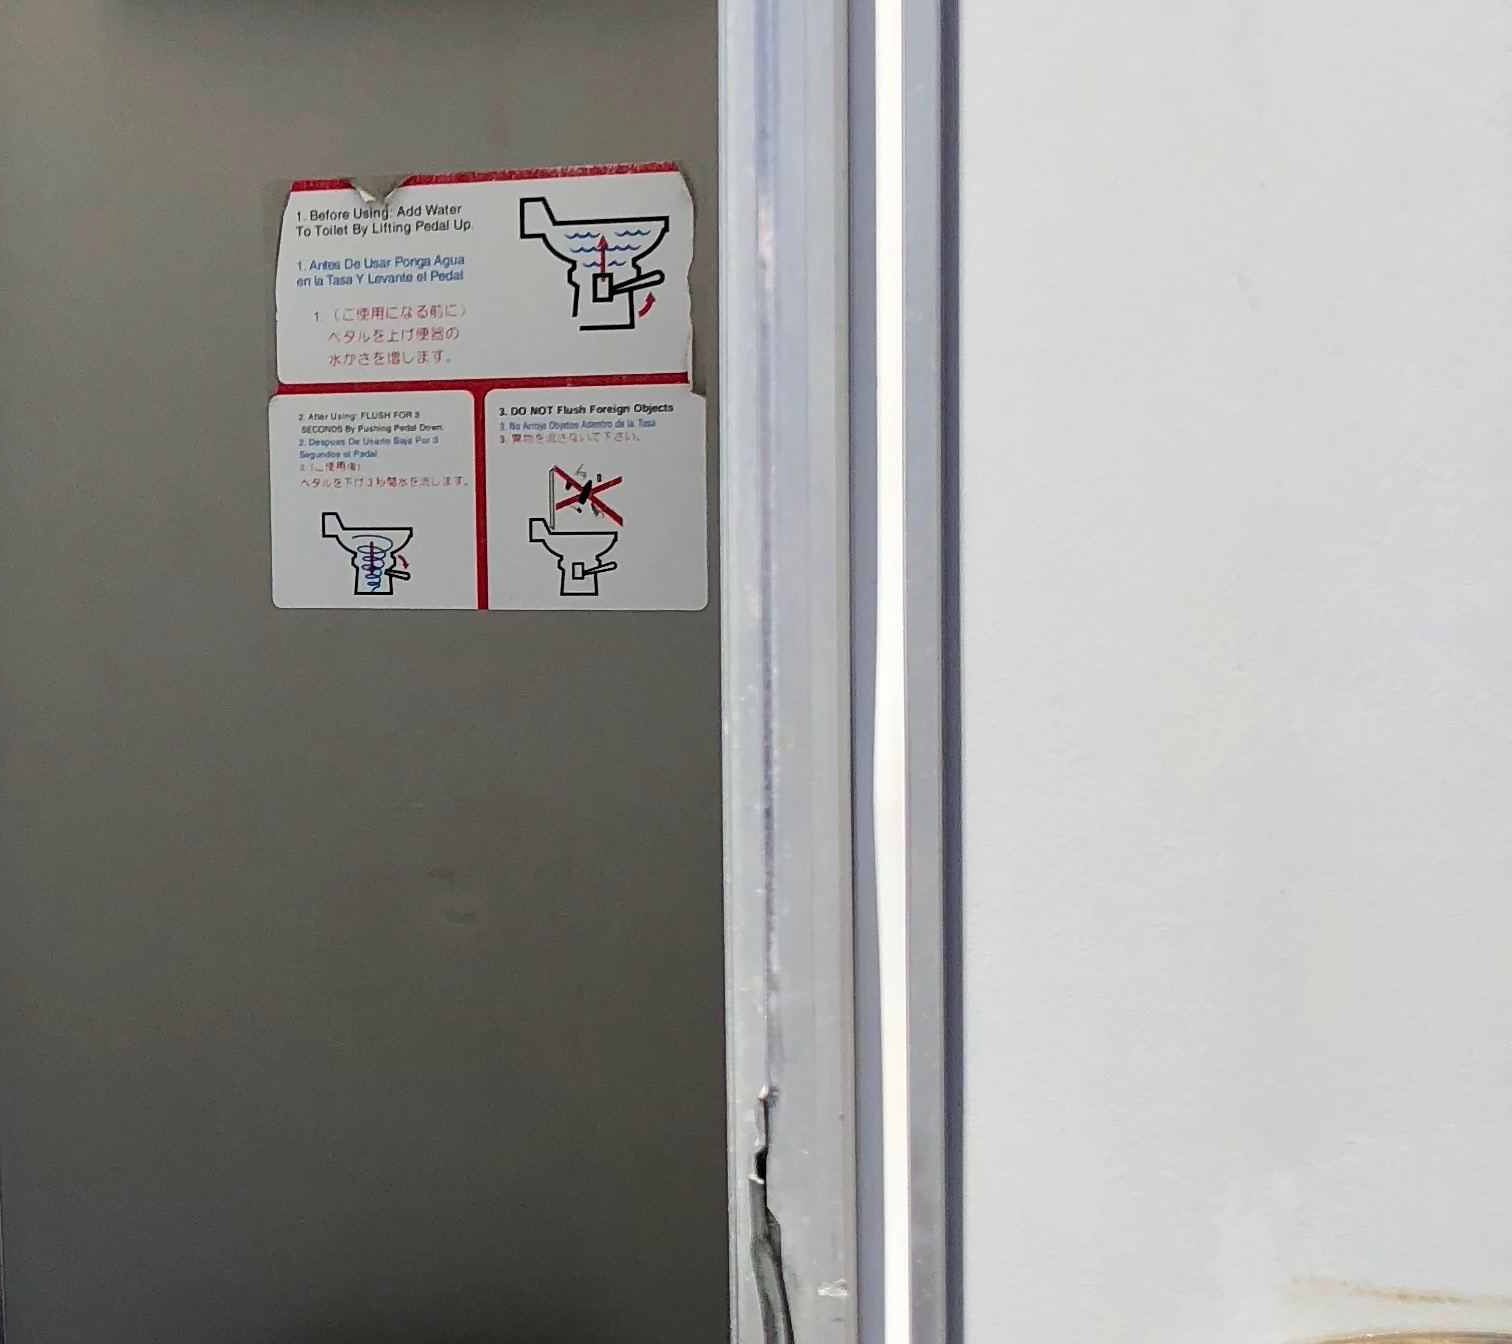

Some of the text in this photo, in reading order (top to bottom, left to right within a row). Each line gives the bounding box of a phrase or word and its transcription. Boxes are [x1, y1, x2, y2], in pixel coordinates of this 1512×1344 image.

[309, 209, 350, 221] Before
[353, 206, 393, 222] Using:
[396, 206, 422, 218] Add
[425, 203, 462, 217] Water
[295, 226, 311, 238] To
[314, 224, 348, 236] Toilet
[352, 223, 368, 238] By
[372, 220, 411, 236] Lifting
[415, 219, 449, 232] Pedal
[309, 259, 341, 271] Antes
[344, 258, 360, 270] De
[364, 257, 392, 269] Usar
[394, 256, 431, 270] Ponga
[434, 254, 465, 268] Agua
[296, 270, 464, 287] en la Tasa Y Levante el Pedal
[308, 412, 328, 421] After
[360, 411, 391, 420] FLUSH
[499, 403, 674, 416] 3. DO NOT Flush Foreign Objects
[301, 426, 343, 434] SECONDS
[344, 425, 356, 434] By
[358, 424, 392, 434] Pushing
[394, 424, 416, 432] Pedal
[548, 420, 580, 431] Objetos
[638, 418, 656, 428] Tasa
[348, 438, 360, 446] De
[415, 436, 430, 444] Por
[300, 450, 341, 460] Segundos
[354, 450, 378, 458] Pedal
